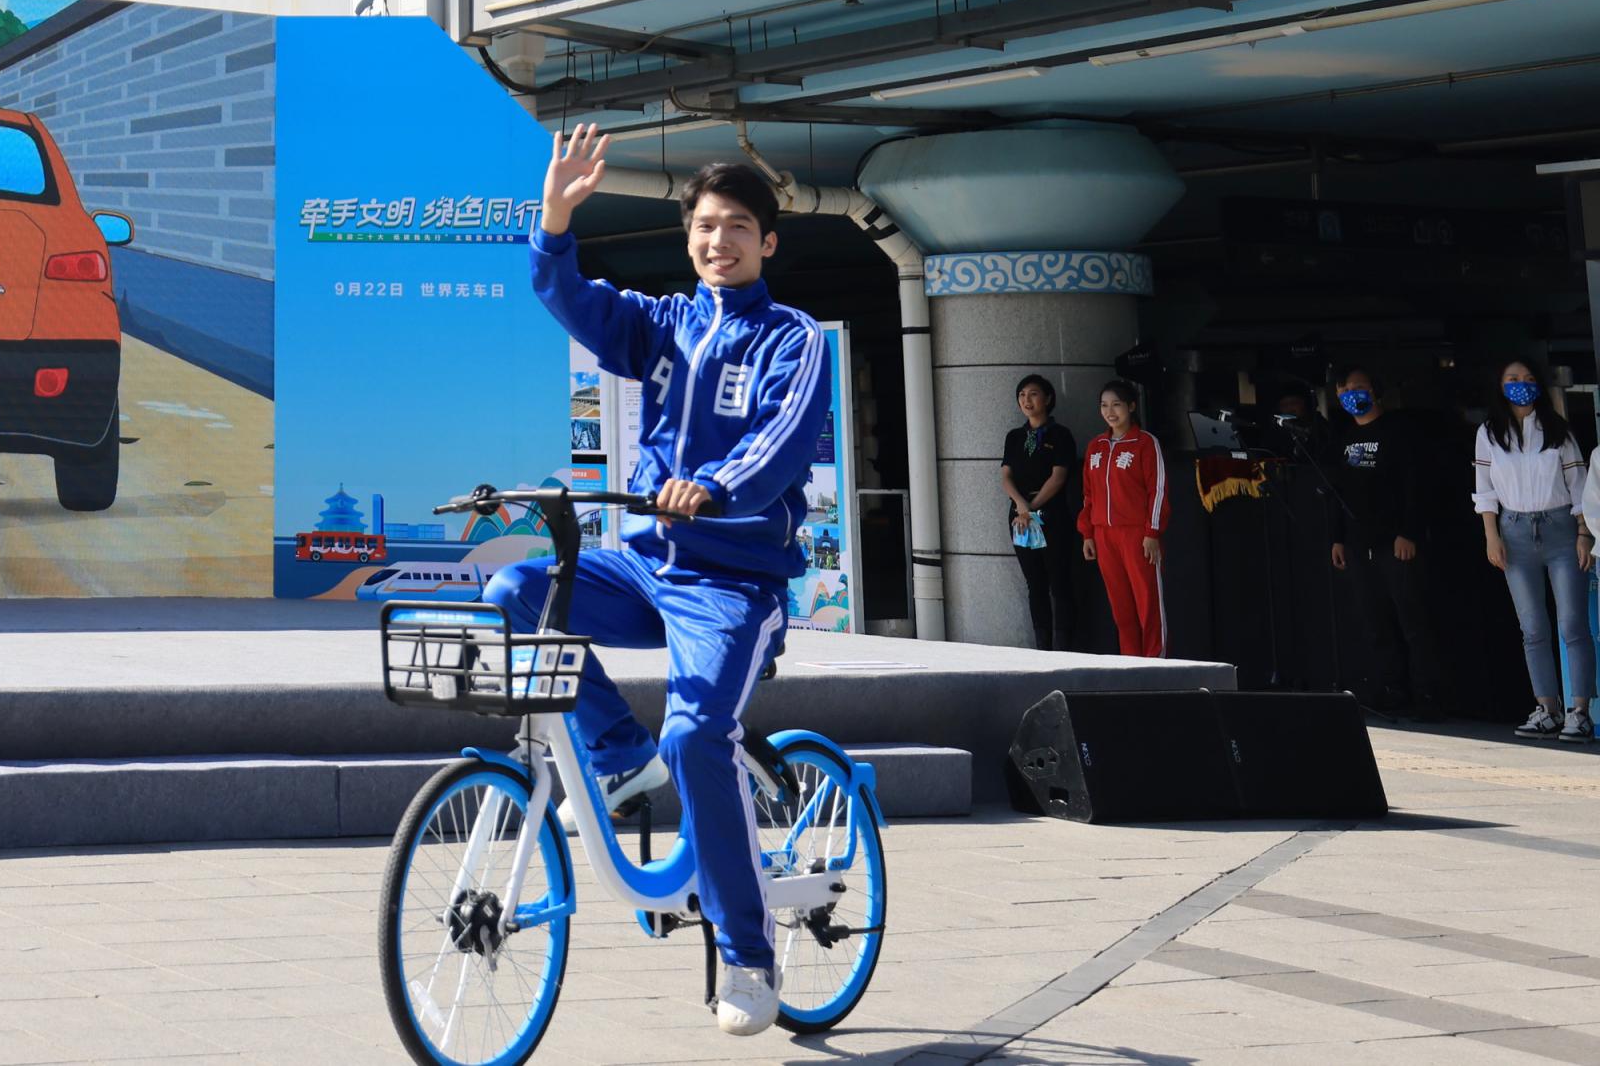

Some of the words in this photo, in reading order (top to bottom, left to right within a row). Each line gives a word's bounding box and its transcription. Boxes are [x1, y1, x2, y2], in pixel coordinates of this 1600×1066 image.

[299, 197, 416, 240] 牵手文明
[420, 194, 542, 240] 绿色同行
[334, 282, 404, 297] 9月22日
[420, 282, 505, 298] 世界无车日
